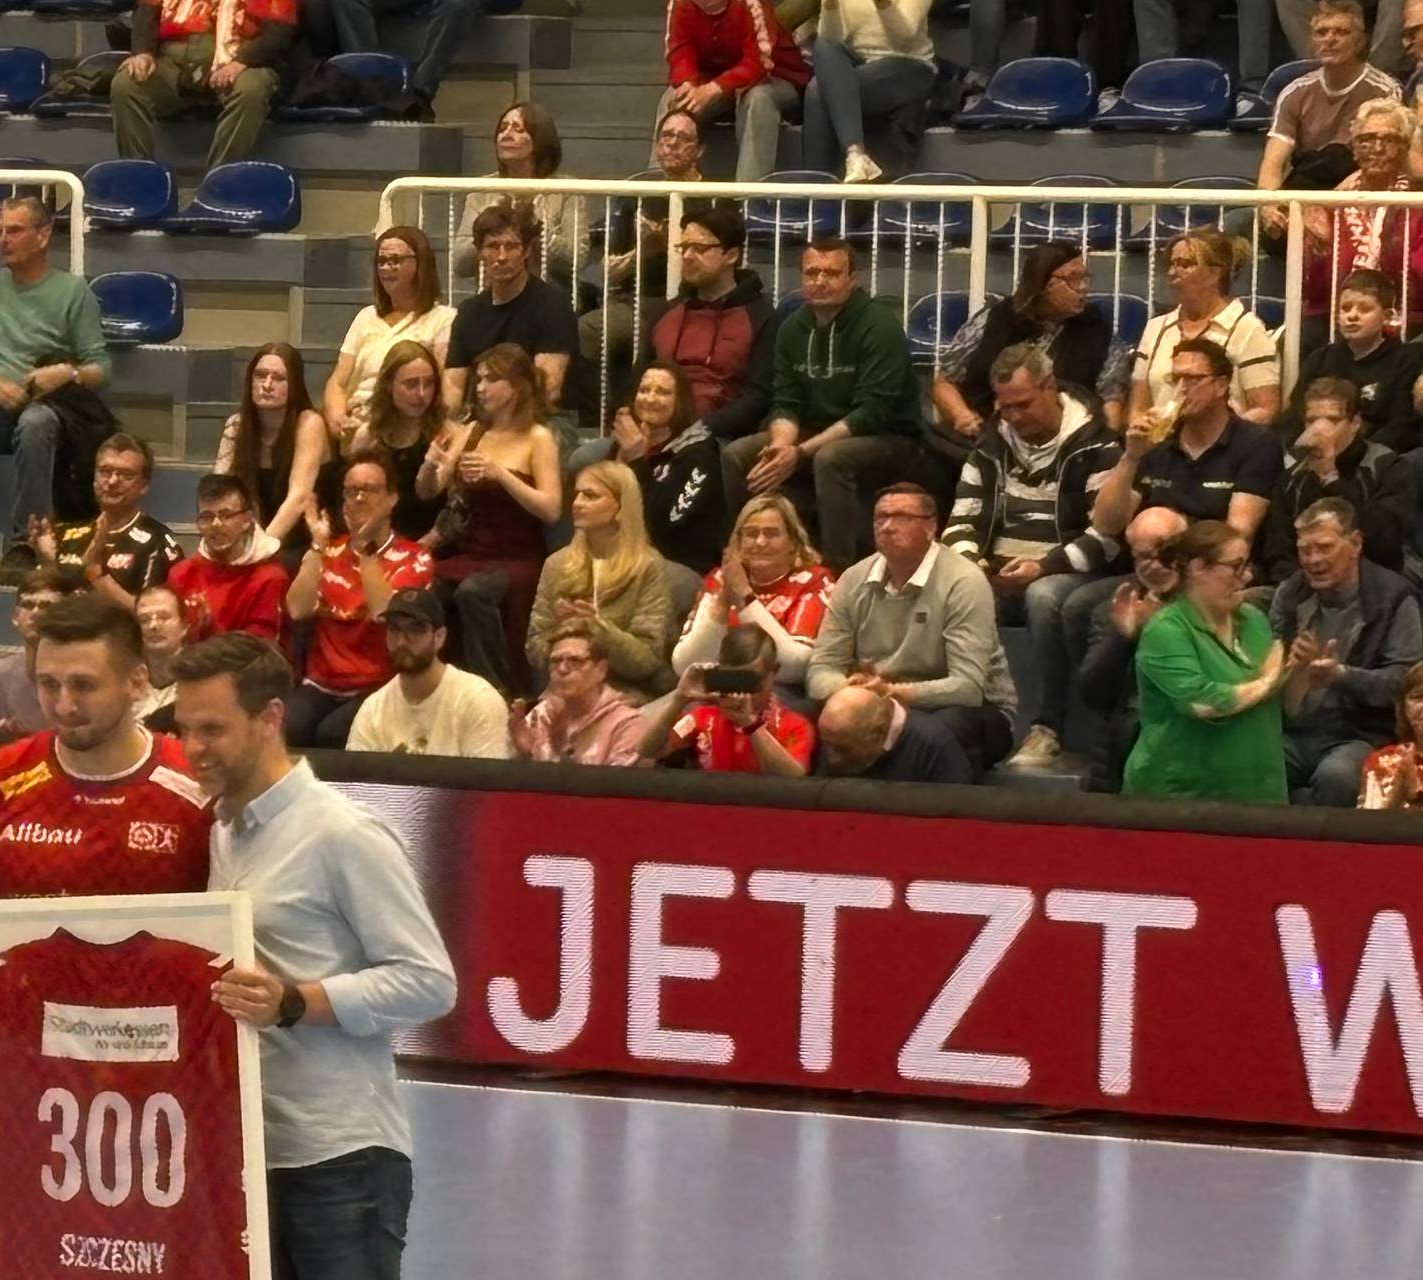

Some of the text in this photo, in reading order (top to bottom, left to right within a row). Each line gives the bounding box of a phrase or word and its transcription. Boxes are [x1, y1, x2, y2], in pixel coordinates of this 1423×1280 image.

[487, 854, 1198, 1096] JETZT
[38, 1088, 186, 1208] 300
[60, 1233, 165, 1273] SZCZESNY
